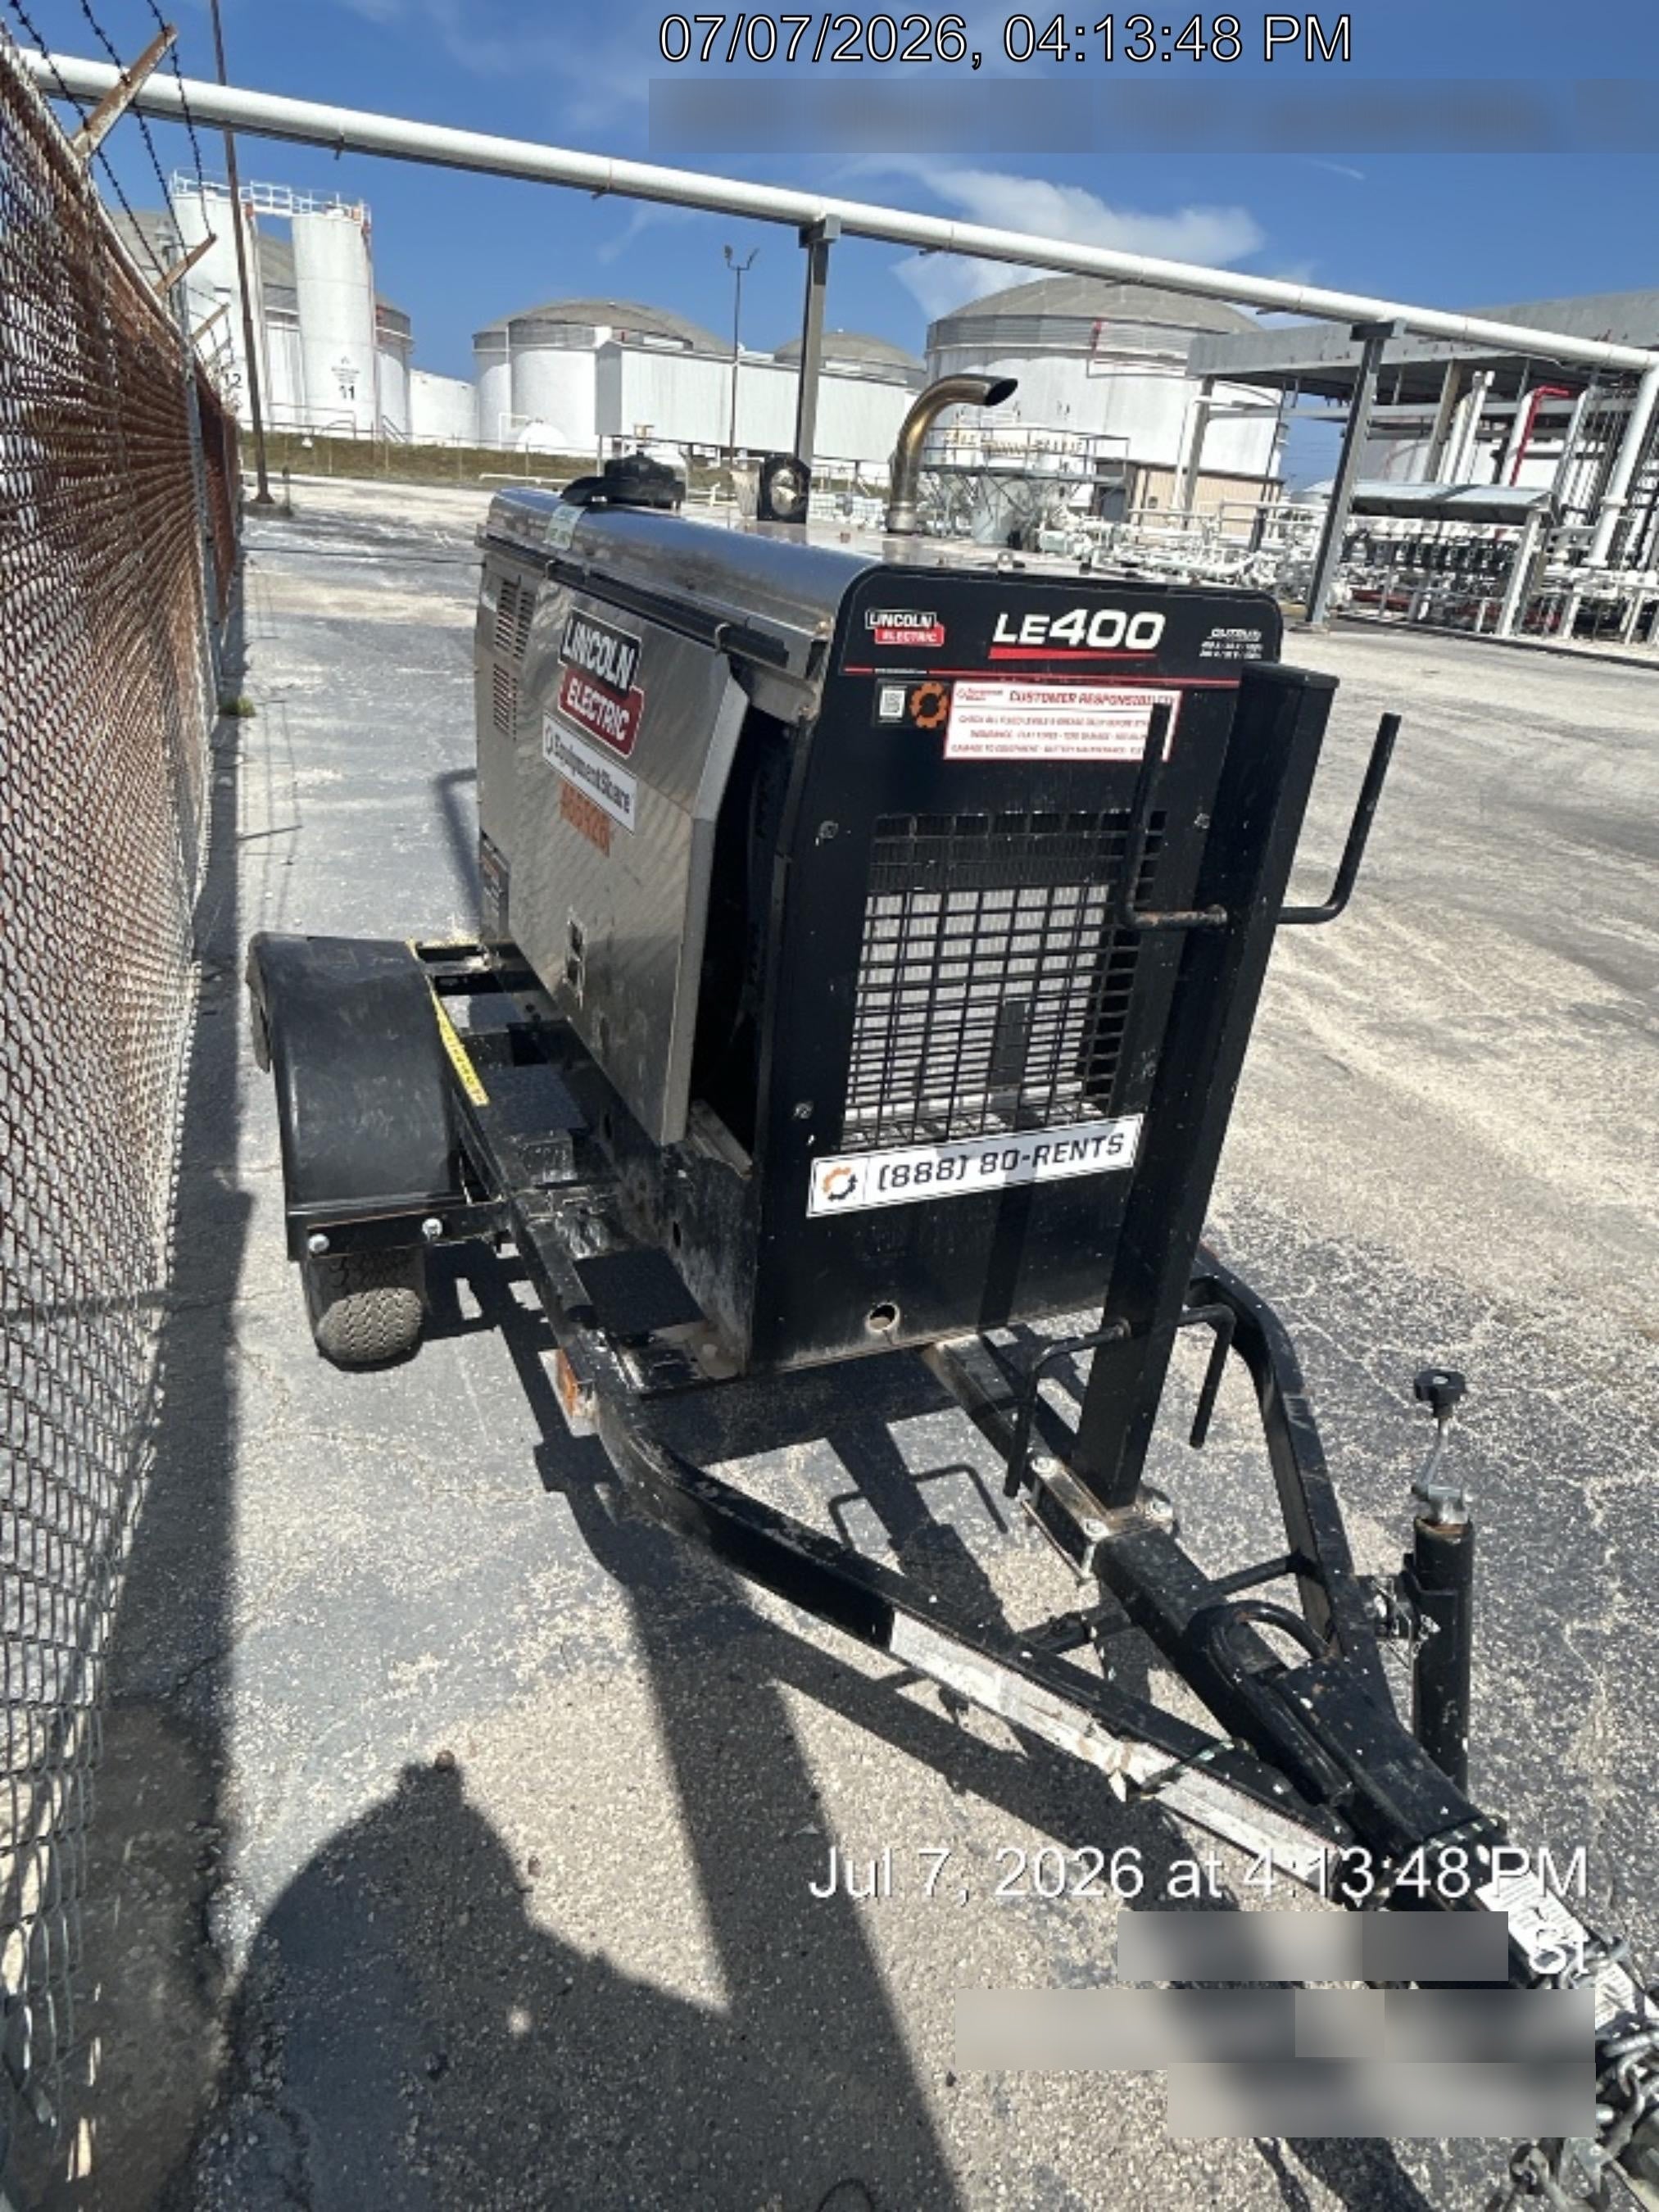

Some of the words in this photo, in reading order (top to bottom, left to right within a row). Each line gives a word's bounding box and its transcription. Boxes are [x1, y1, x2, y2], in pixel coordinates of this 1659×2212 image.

[869, 613, 932, 628] LINCOLN
[882, 631, 938, 642] ELECTRIC
[992, 609, 1166, 650] LE400
[562, 618, 635, 691] LINCOLN
[567, 678, 630, 741] ELECTRIC
[878, 1154, 967, 1191] (888)
[979, 1132, 1126, 1175] 80-RENTS
